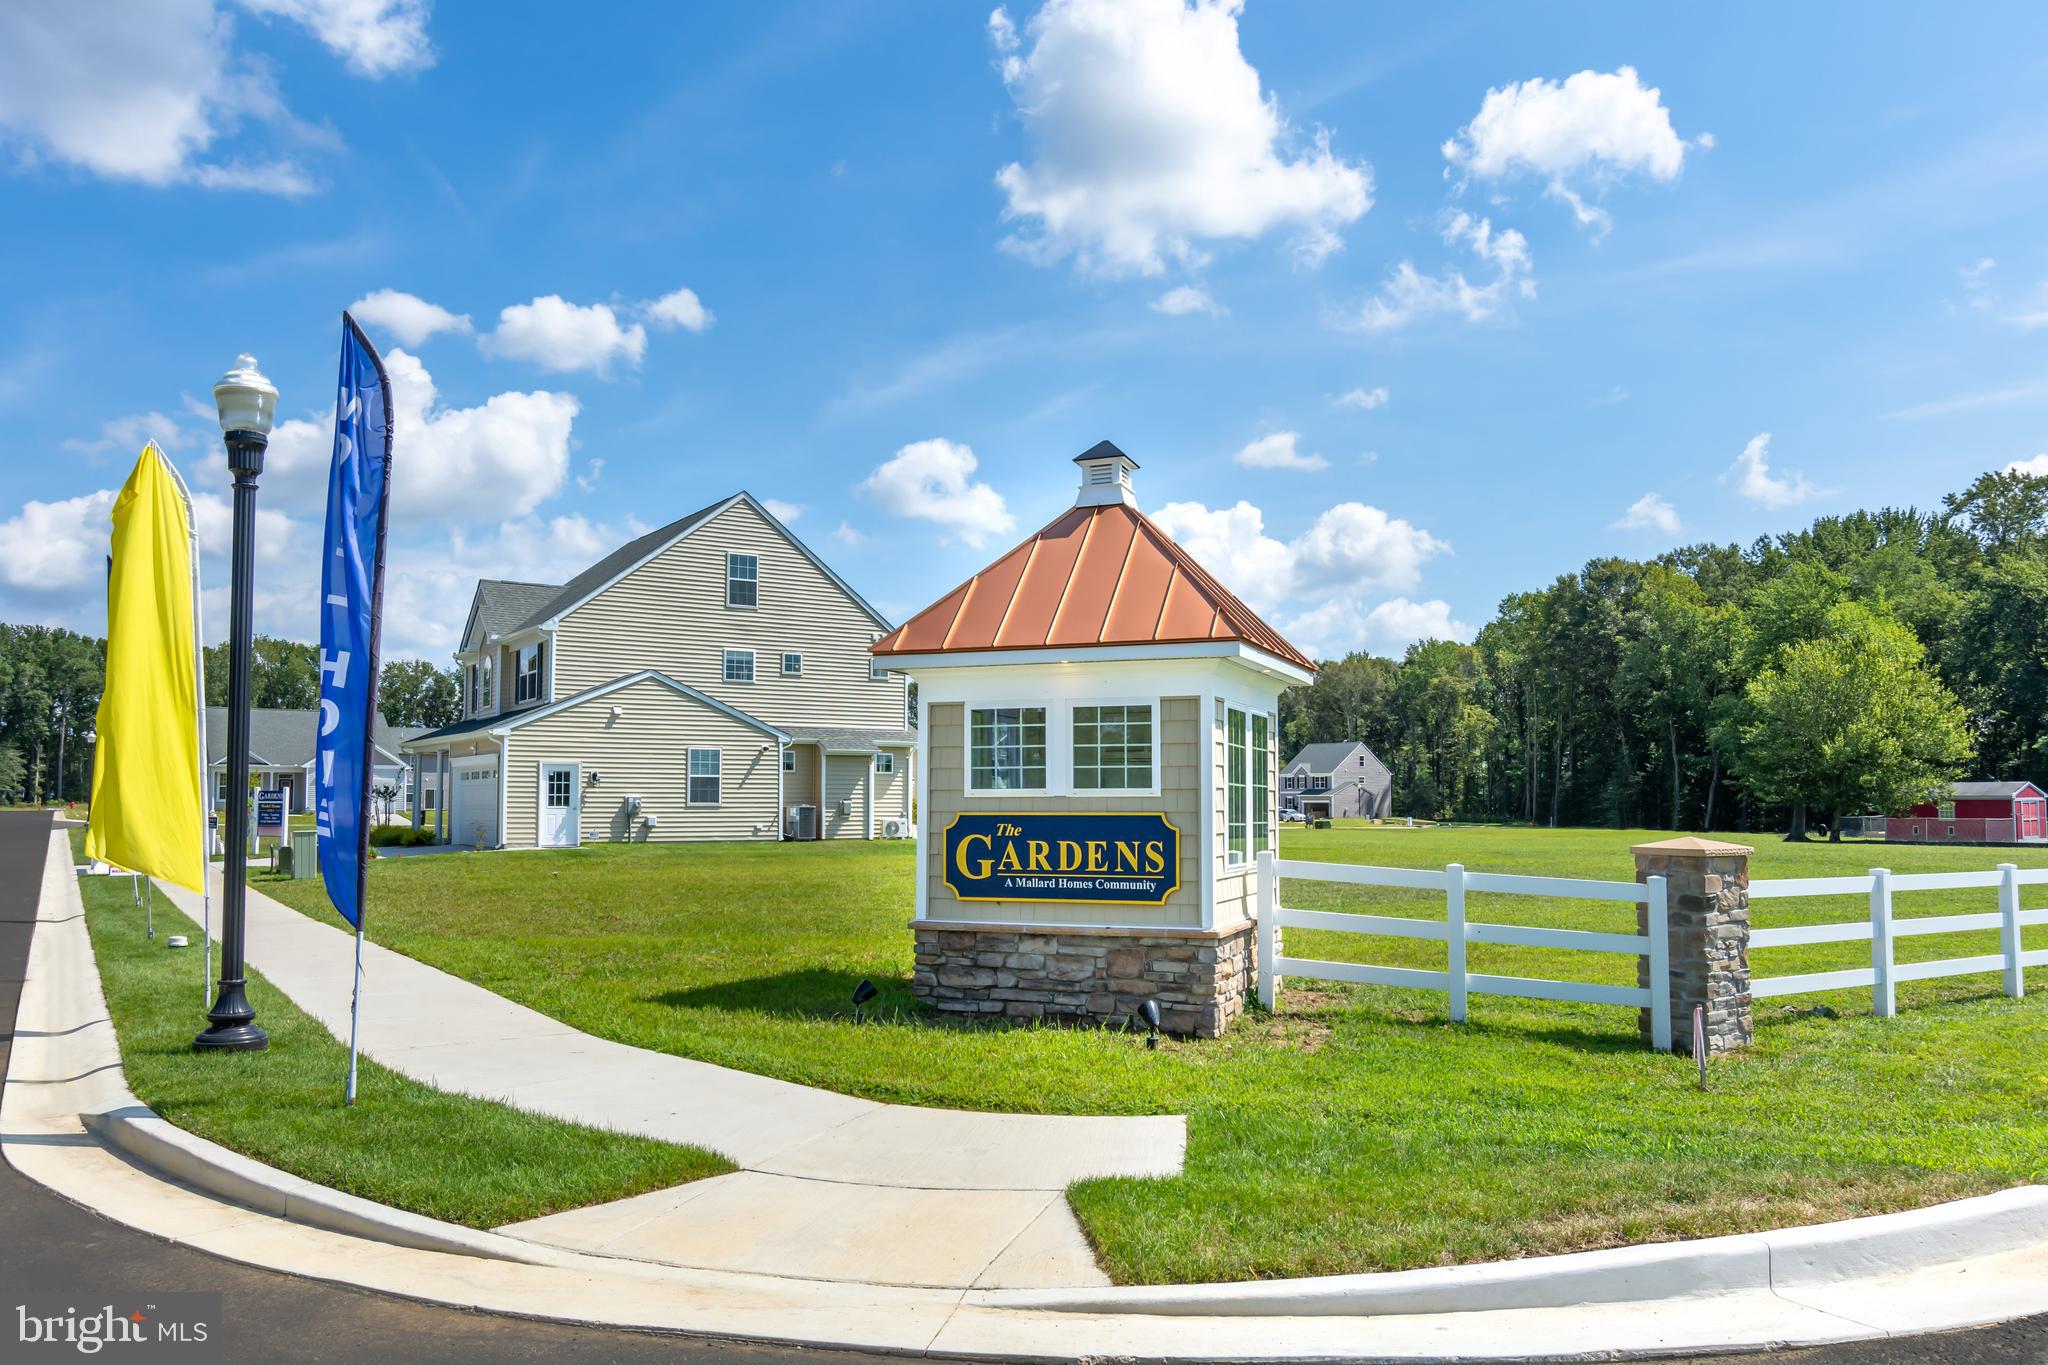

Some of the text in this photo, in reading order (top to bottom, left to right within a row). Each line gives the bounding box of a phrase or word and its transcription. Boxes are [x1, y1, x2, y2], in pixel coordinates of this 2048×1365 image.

[996, 823, 1022, 837] The
[955, 834, 1165, 880] GARDENS
[1004, 877, 1157, 892] A Mallard Homes Community
